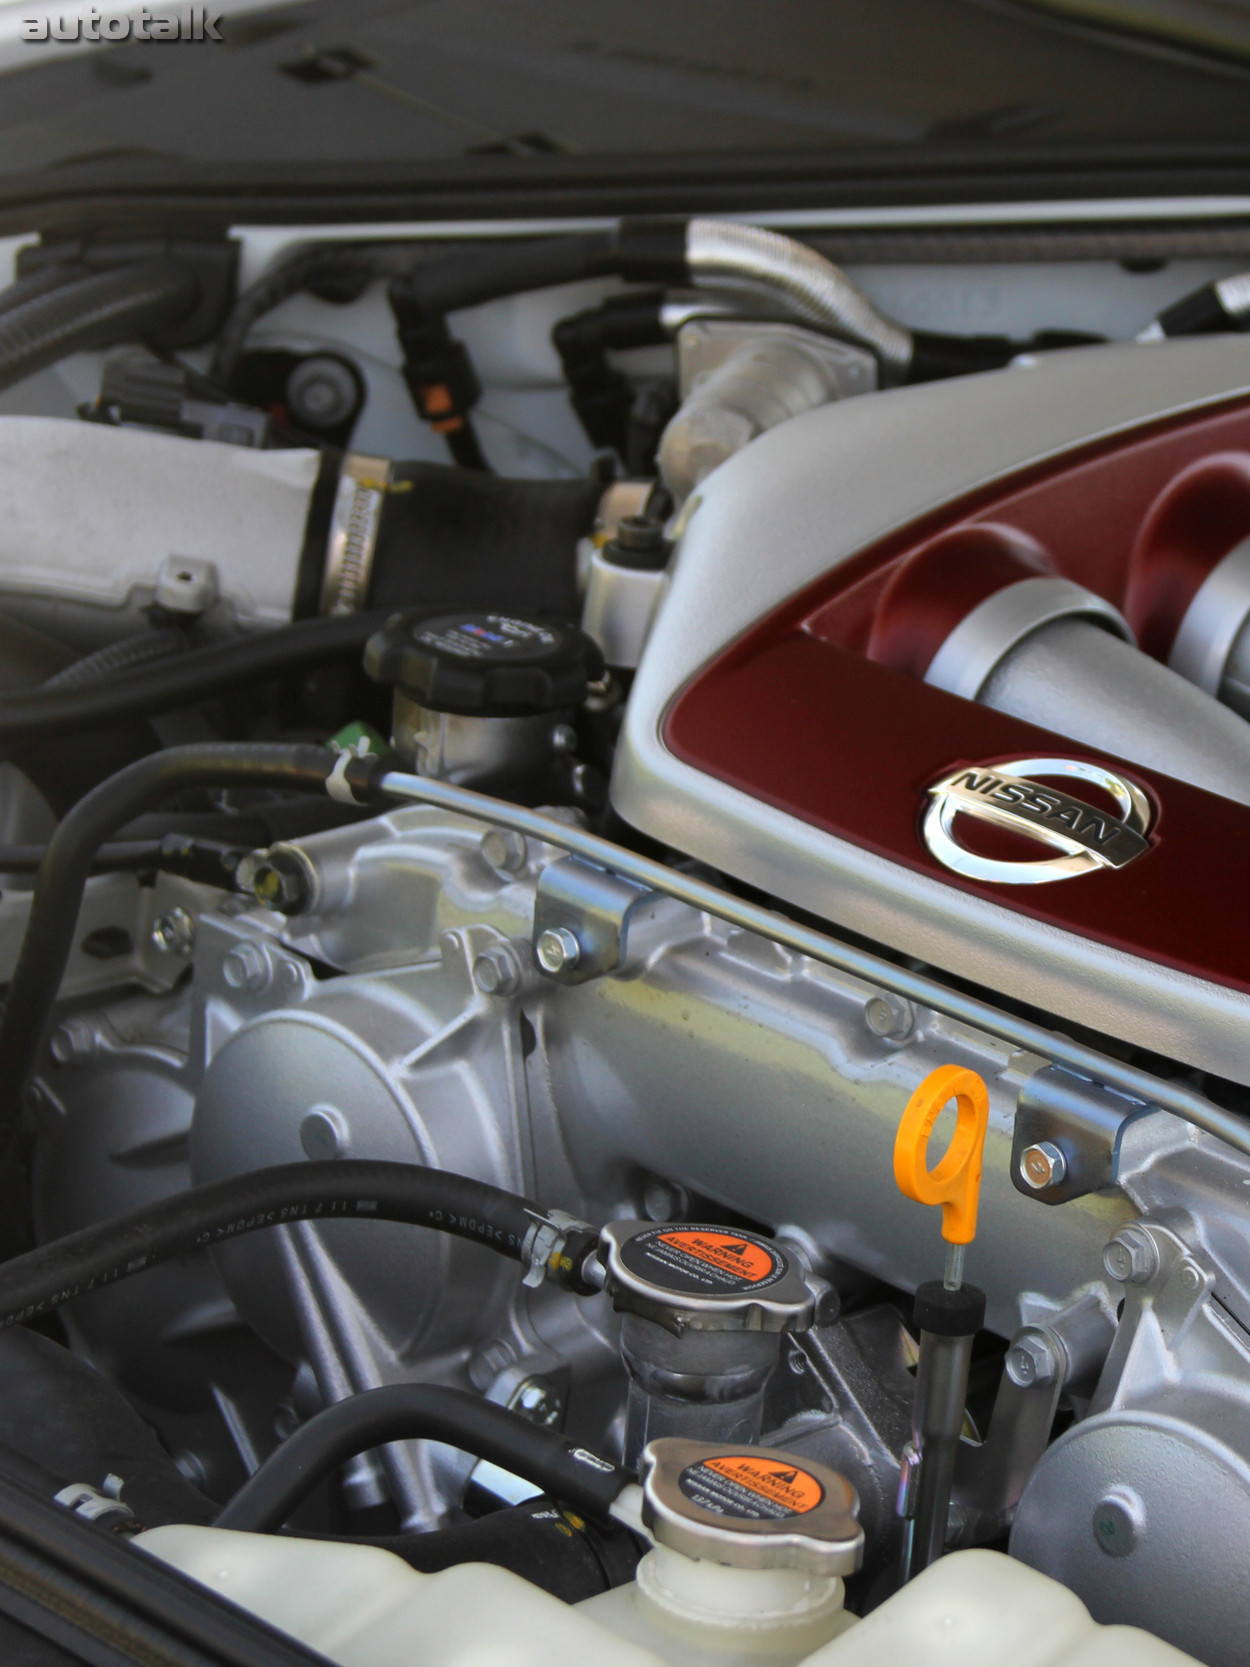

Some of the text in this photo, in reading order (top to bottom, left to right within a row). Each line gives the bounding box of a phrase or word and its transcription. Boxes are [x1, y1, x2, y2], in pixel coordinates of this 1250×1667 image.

[950, 770, 1121, 847] NISSAN
[666, 1236, 758, 1278] AVERTISSEMENT
[691, 1238, 755, 1269] WARNING
[710, 1461, 809, 1509] AVERTISSEMENT
[737, 1463, 806, 1498] WARNING
